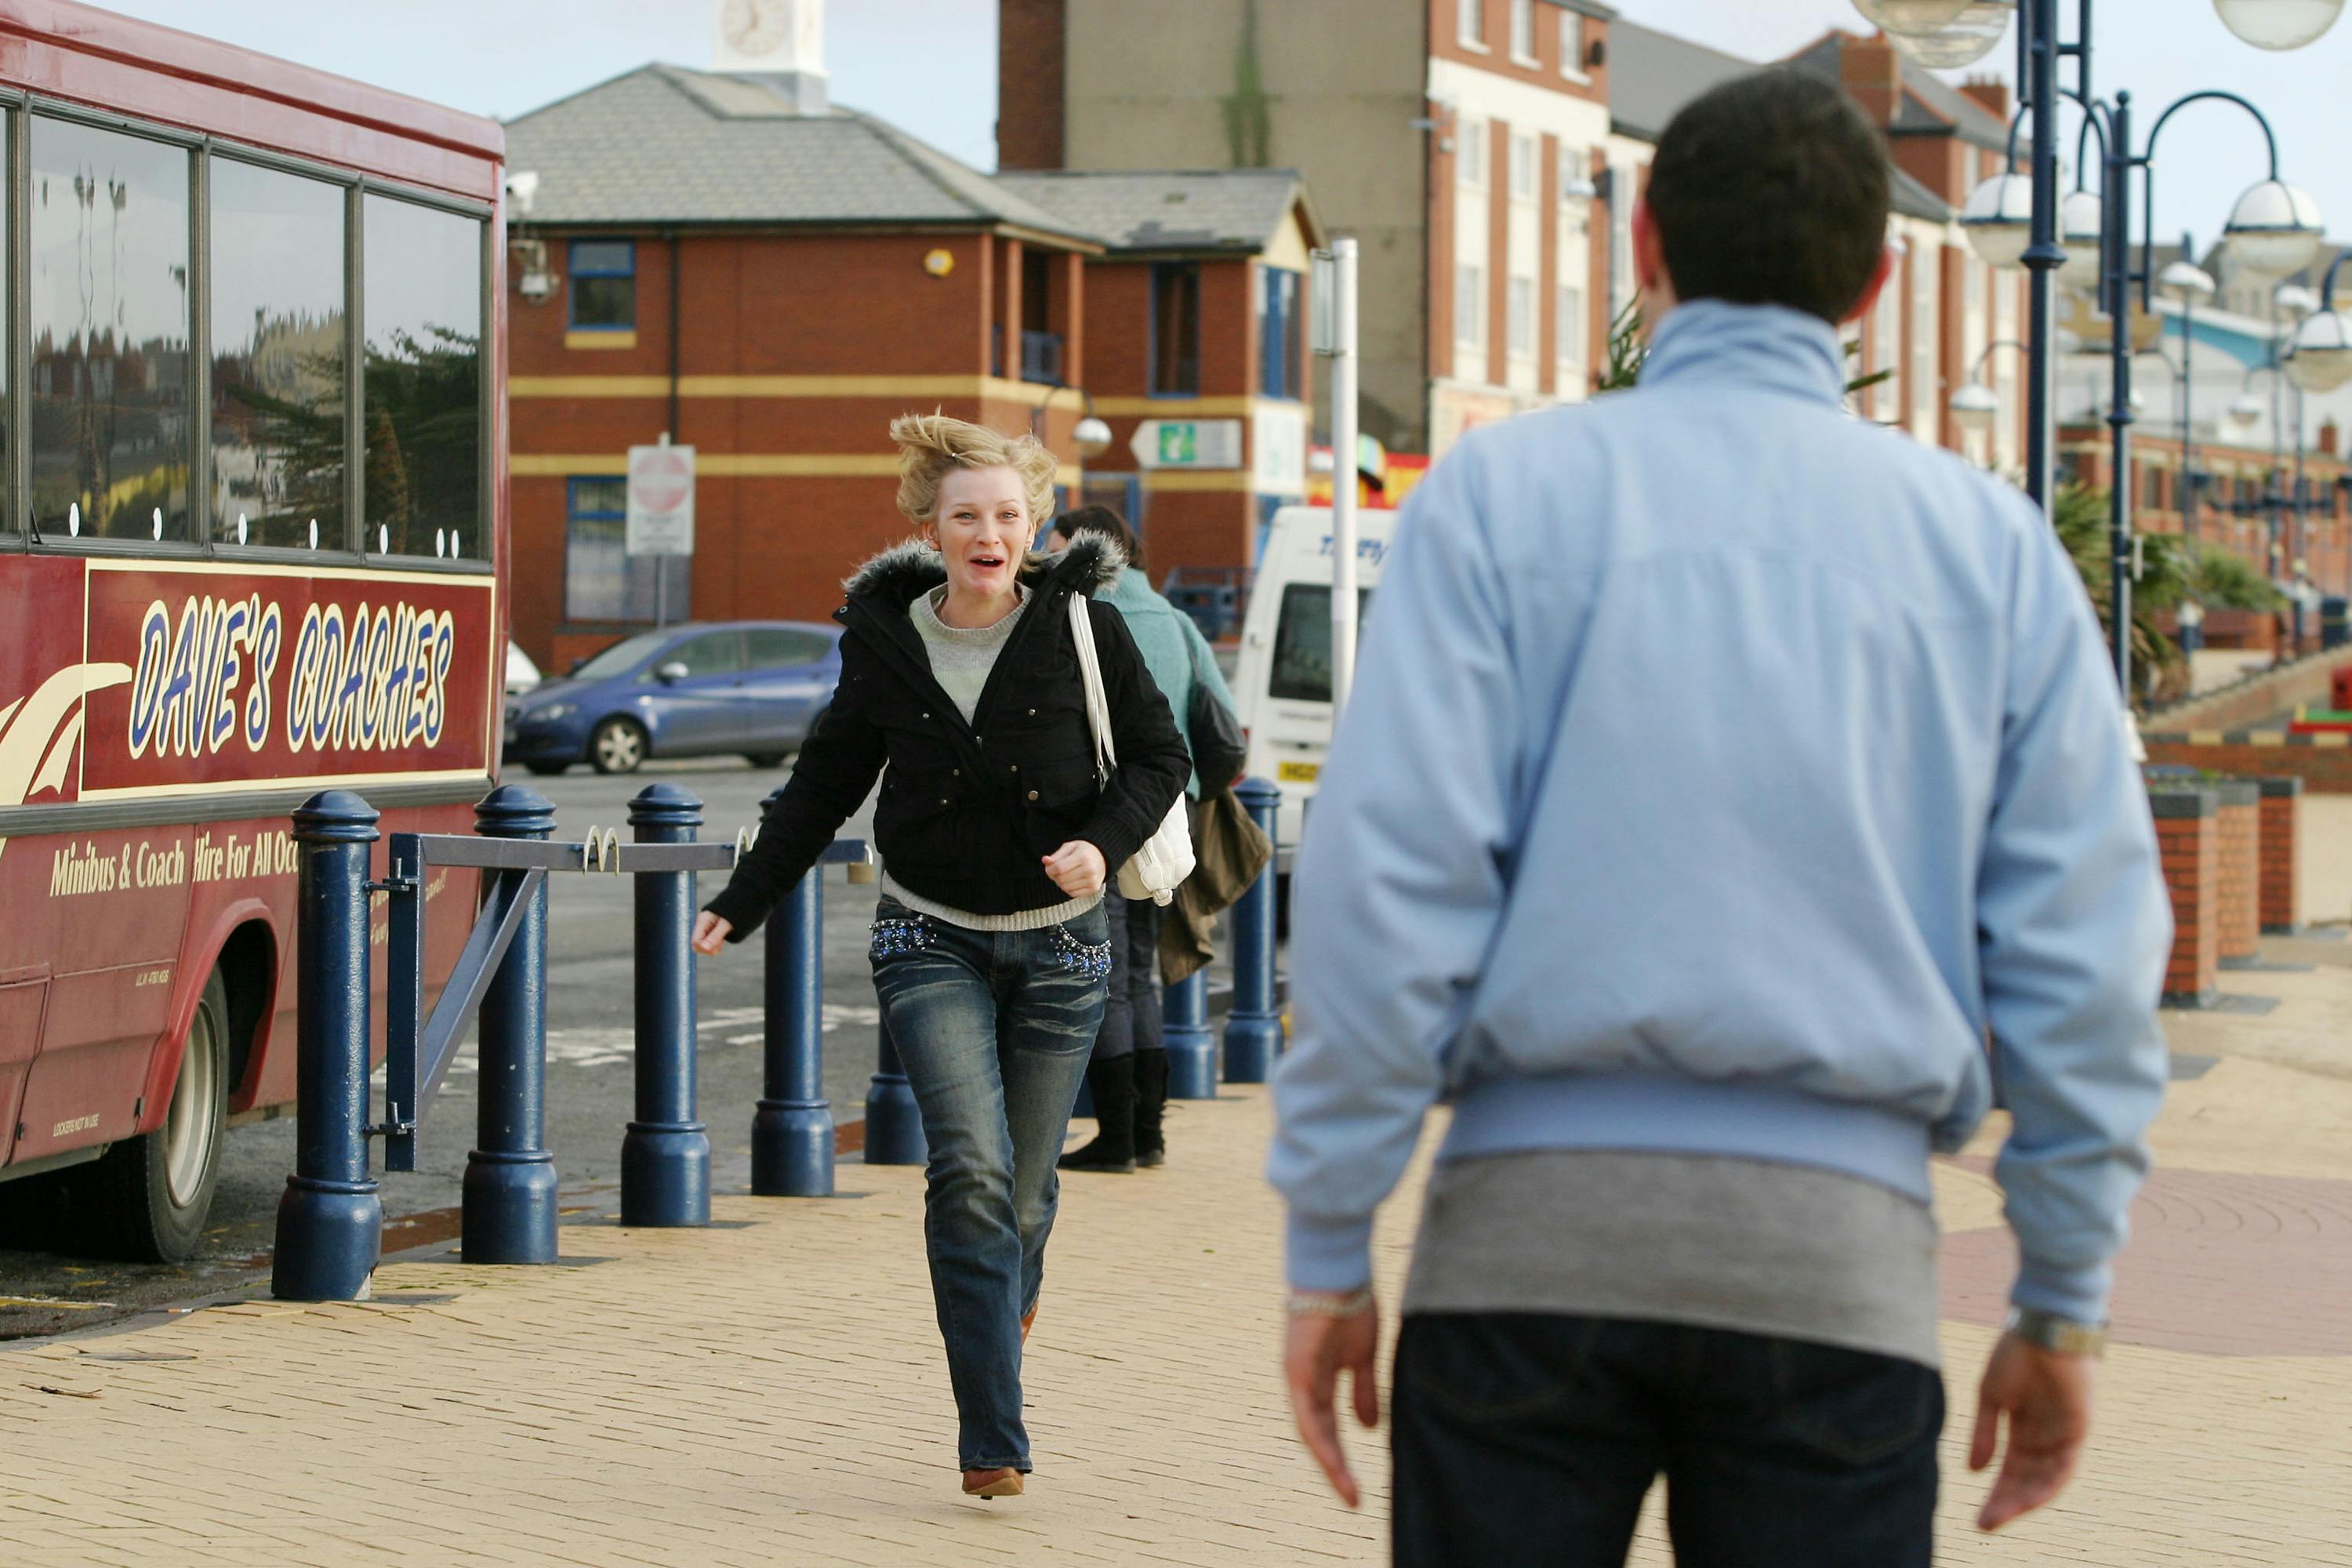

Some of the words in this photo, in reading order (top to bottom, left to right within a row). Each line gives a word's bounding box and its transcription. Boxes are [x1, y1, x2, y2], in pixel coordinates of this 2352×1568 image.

[129, 592, 281, 760] DAVE'S
[287, 601, 454, 753] COACHES
[49, 840, 117, 897] Minibus
[118, 843, 131, 890] &
[136, 840, 185, 888] Coach
[193, 830, 223, 883] Hire
[226, 835, 251, 879] For
[252, 832, 272, 877] All
[275, 830, 298, 874] Occ
